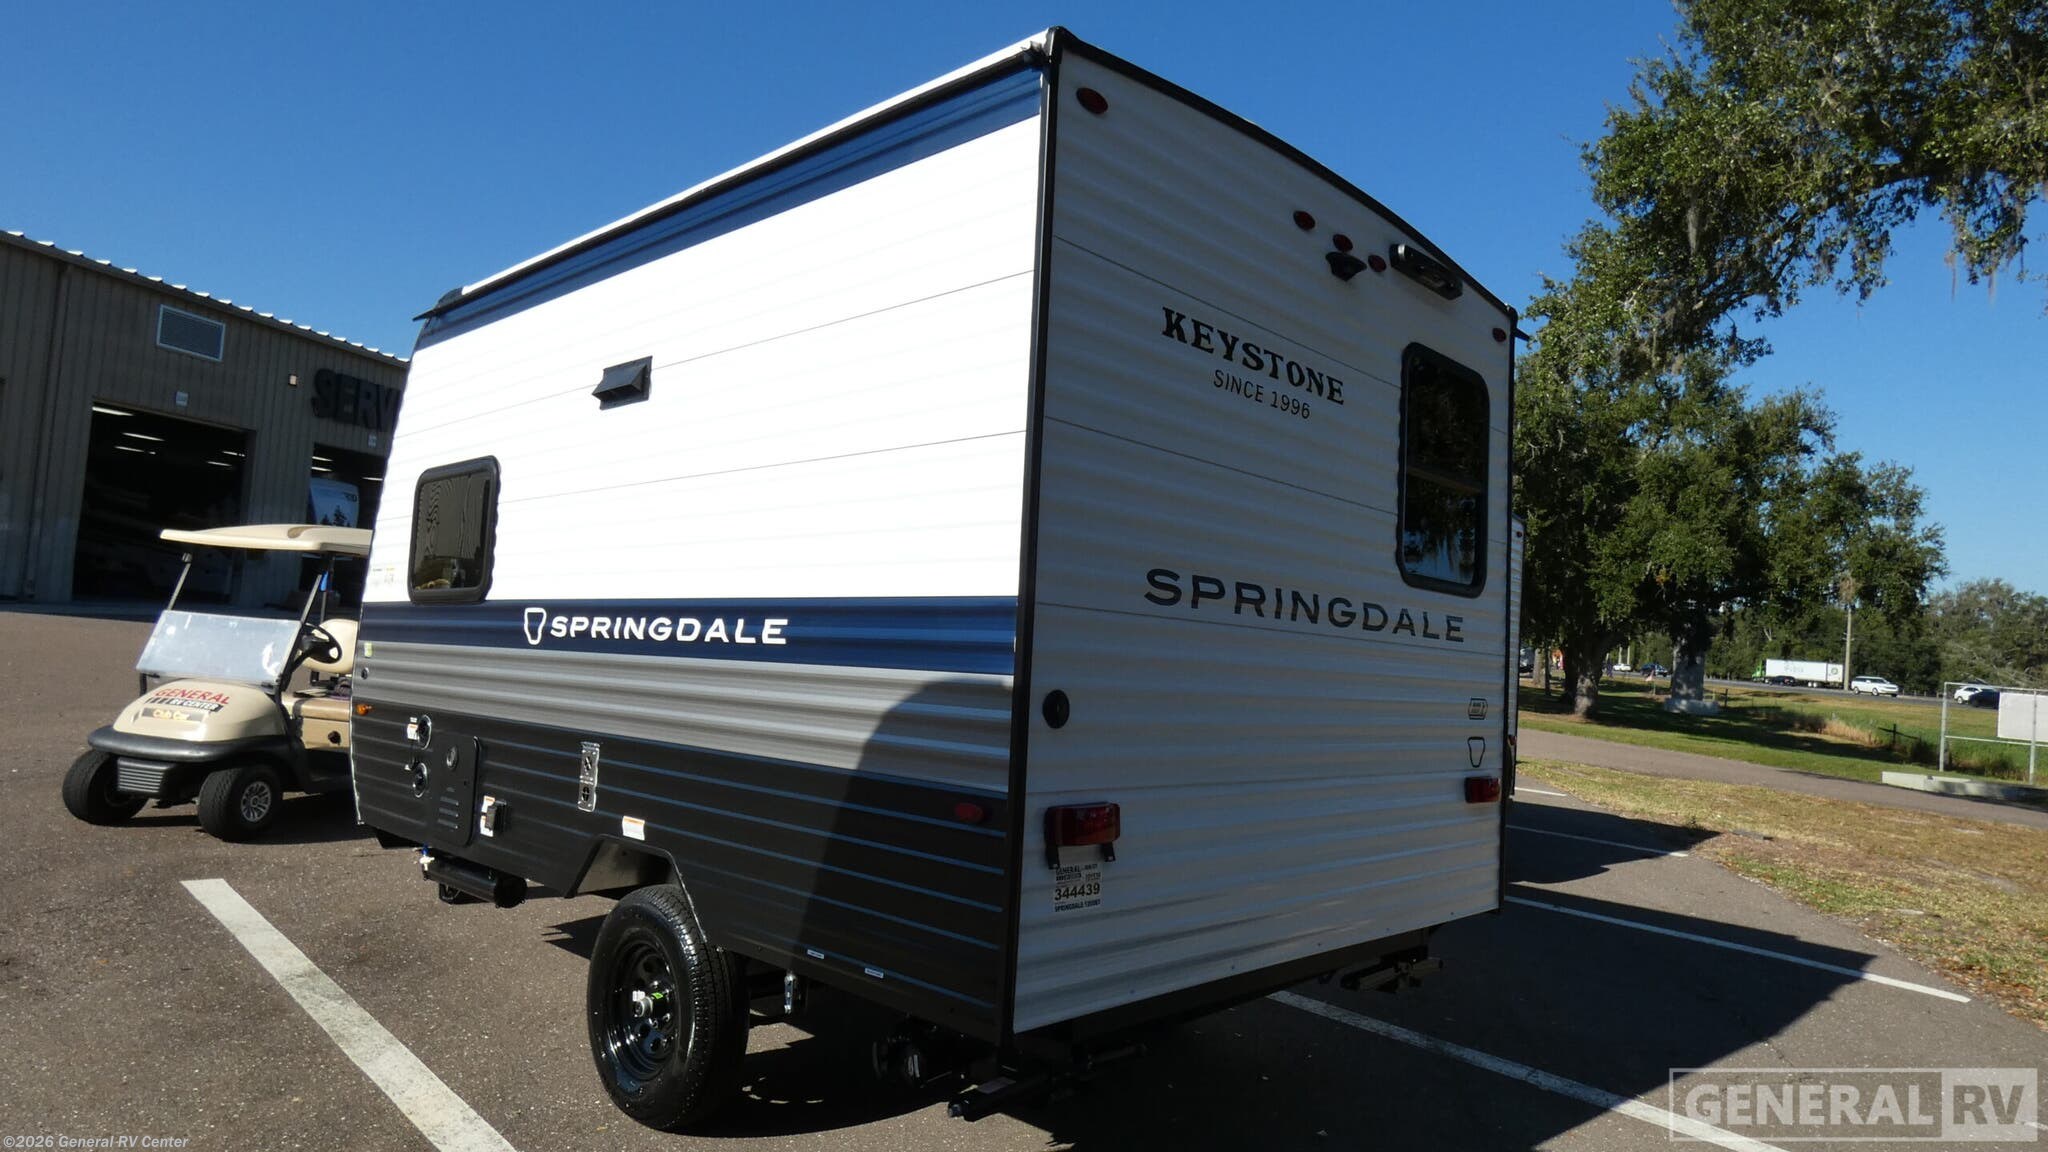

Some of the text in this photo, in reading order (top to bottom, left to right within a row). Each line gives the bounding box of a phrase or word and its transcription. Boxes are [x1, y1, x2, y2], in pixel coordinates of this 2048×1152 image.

[1162, 306, 1345, 405] KEYSTONE
[1213, 369, 1310, 419] SINCE 1996
[1144, 568, 1464, 643] SPRINGDALE
[550, 616, 788, 644] SPRINGDALE
[155, 688, 230, 705] GENERAL
[1054, 882, 1100, 901] 344439
